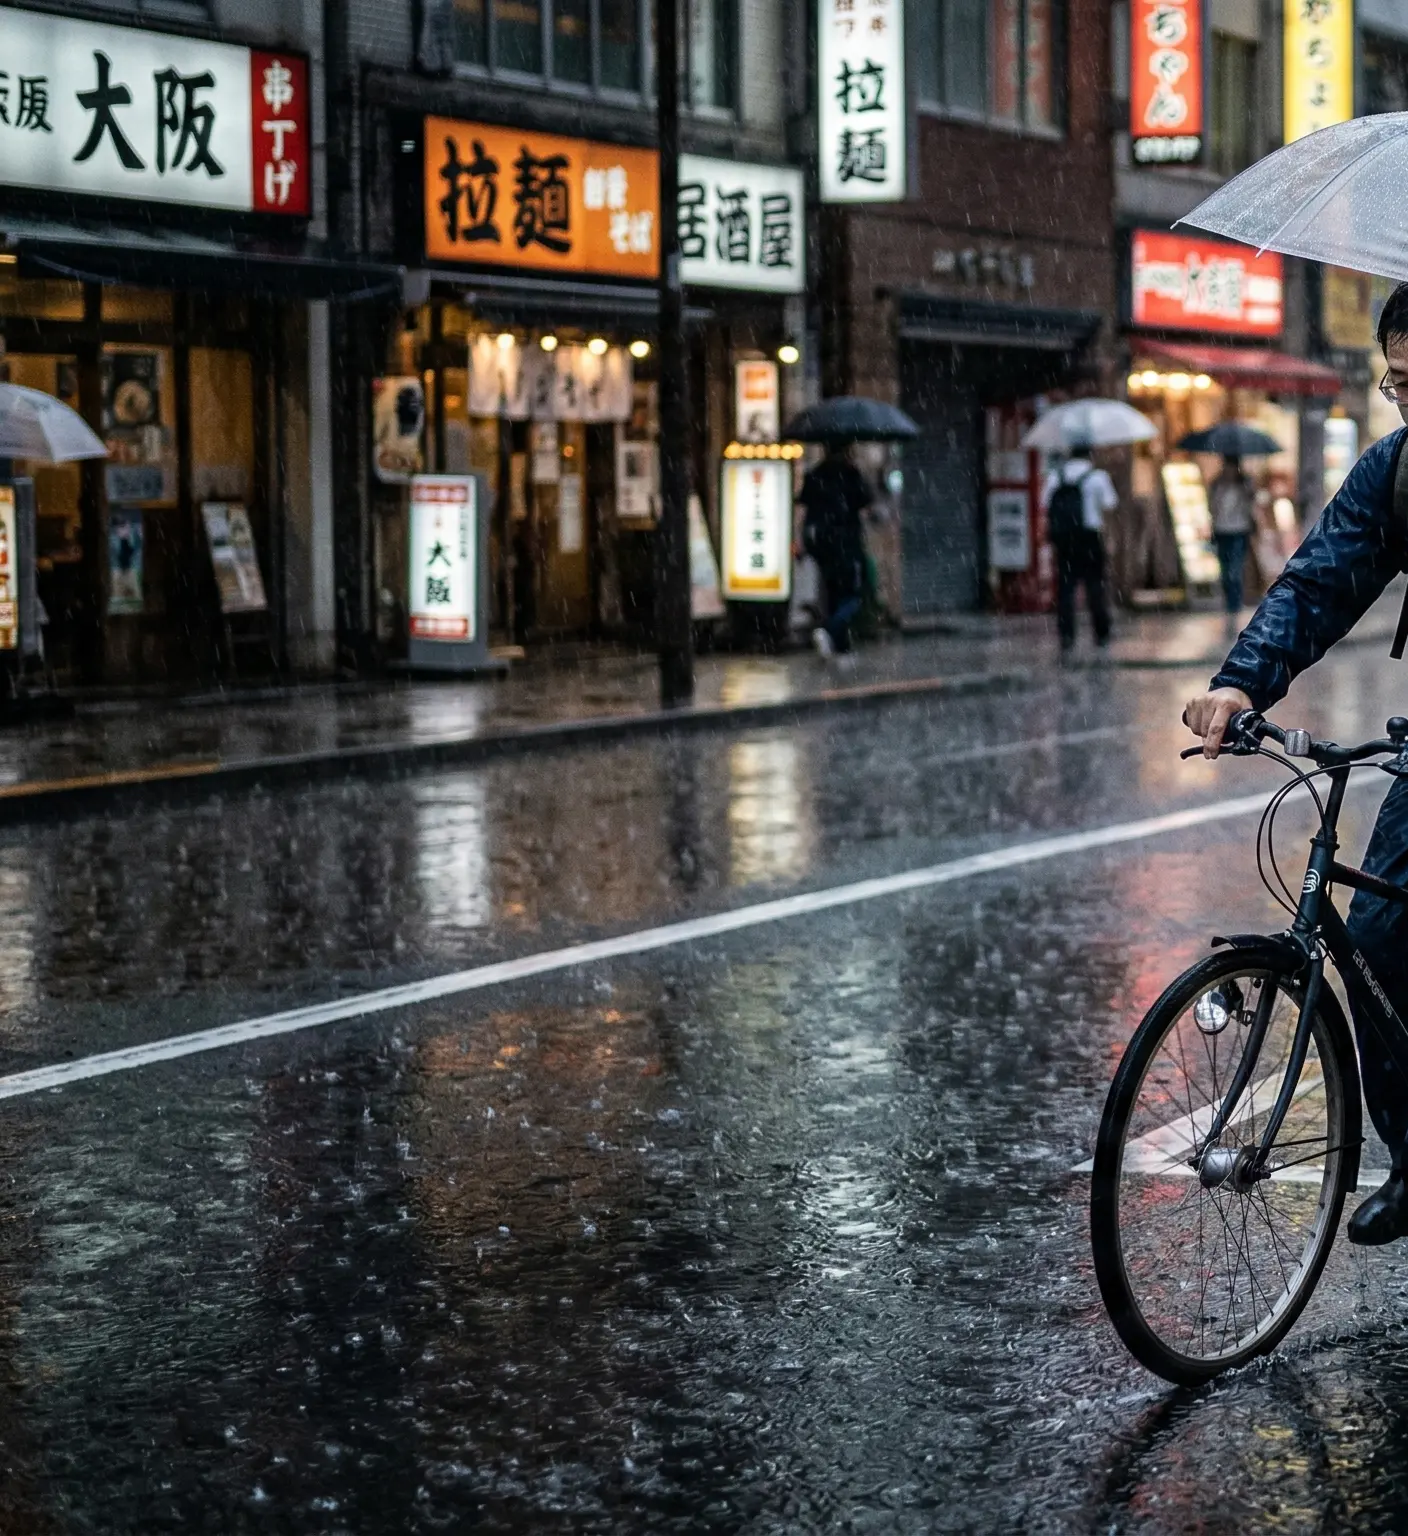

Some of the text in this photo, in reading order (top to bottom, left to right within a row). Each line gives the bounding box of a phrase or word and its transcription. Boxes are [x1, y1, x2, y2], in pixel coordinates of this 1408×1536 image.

[73, 50, 226, 178] 大阪
[678, 183, 792, 268] 居酒屋
